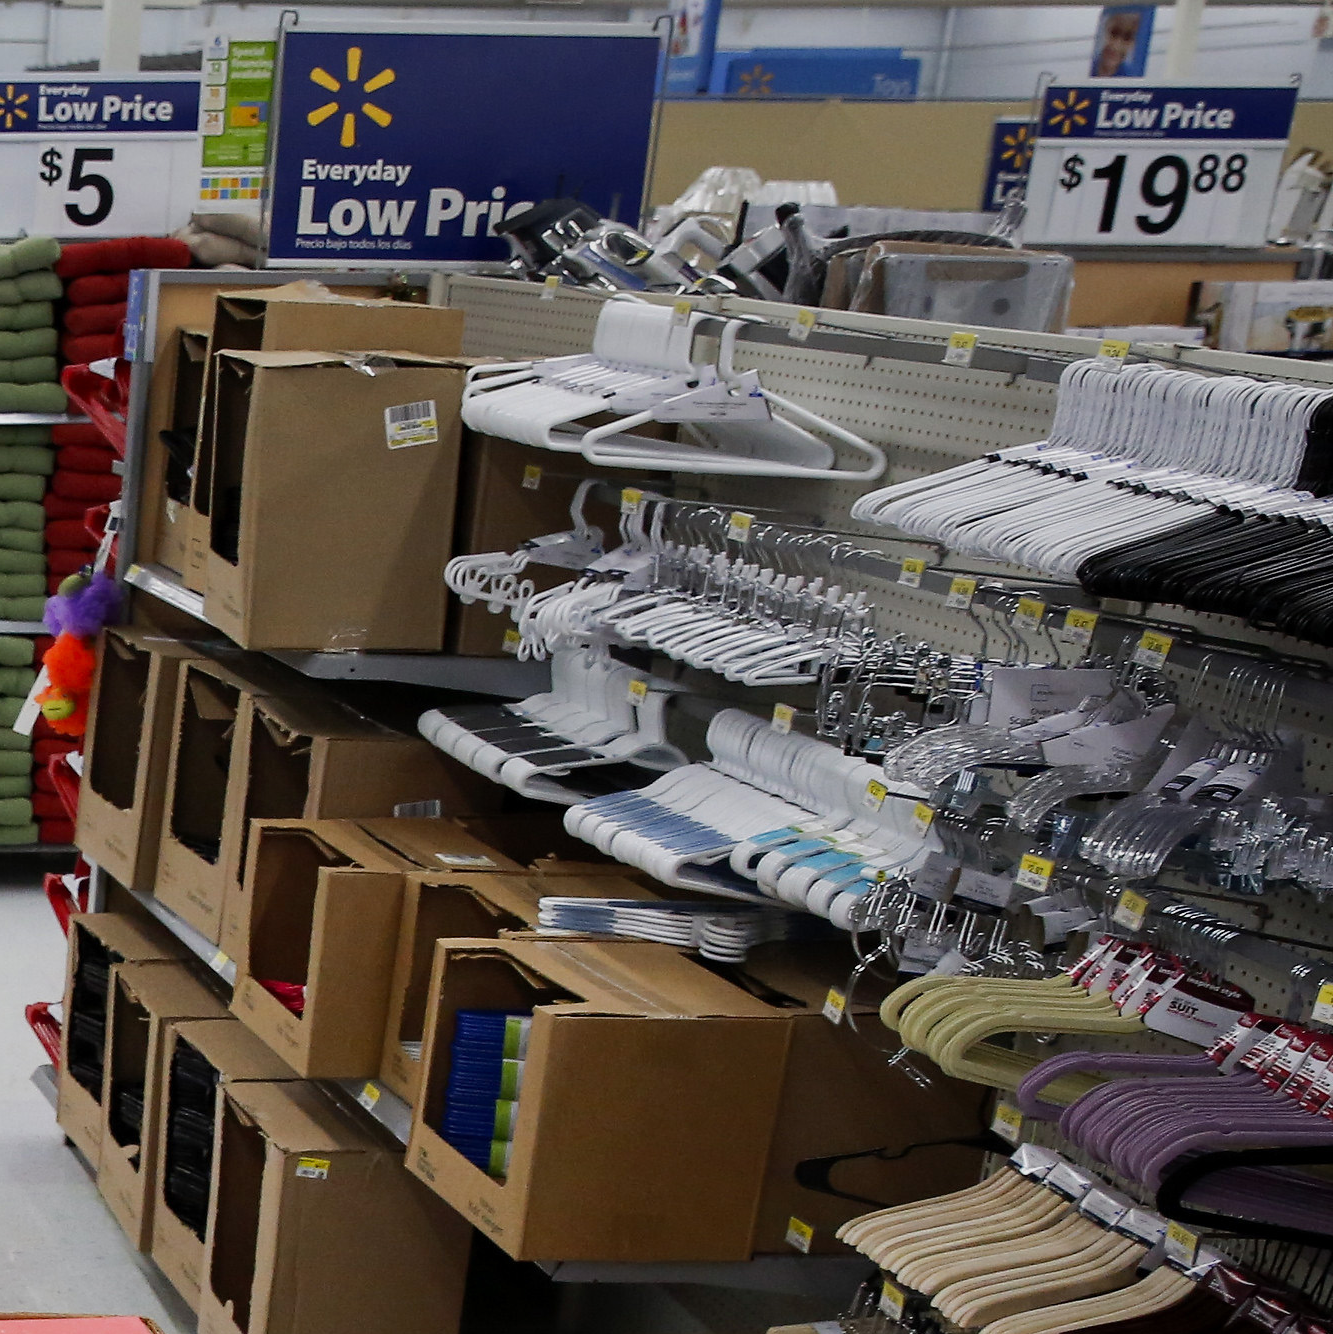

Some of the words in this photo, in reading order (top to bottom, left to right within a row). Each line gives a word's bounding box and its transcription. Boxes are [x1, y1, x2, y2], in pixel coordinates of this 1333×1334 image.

[38, 84, 90, 98] Everyday
[37, 97, 99, 122] Low
[102, 94, 174, 122] Price
[1096, 103, 1156, 130] Low
[1160, 101, 1236, 130] Price
[39, 148, 114, 226] $5
[301, 158, 413, 187] Everyday
[295, 185, 416, 237] Low
[425, 185, 535, 238] Pri
[1168, 1000, 1200, 1017] SUIT
